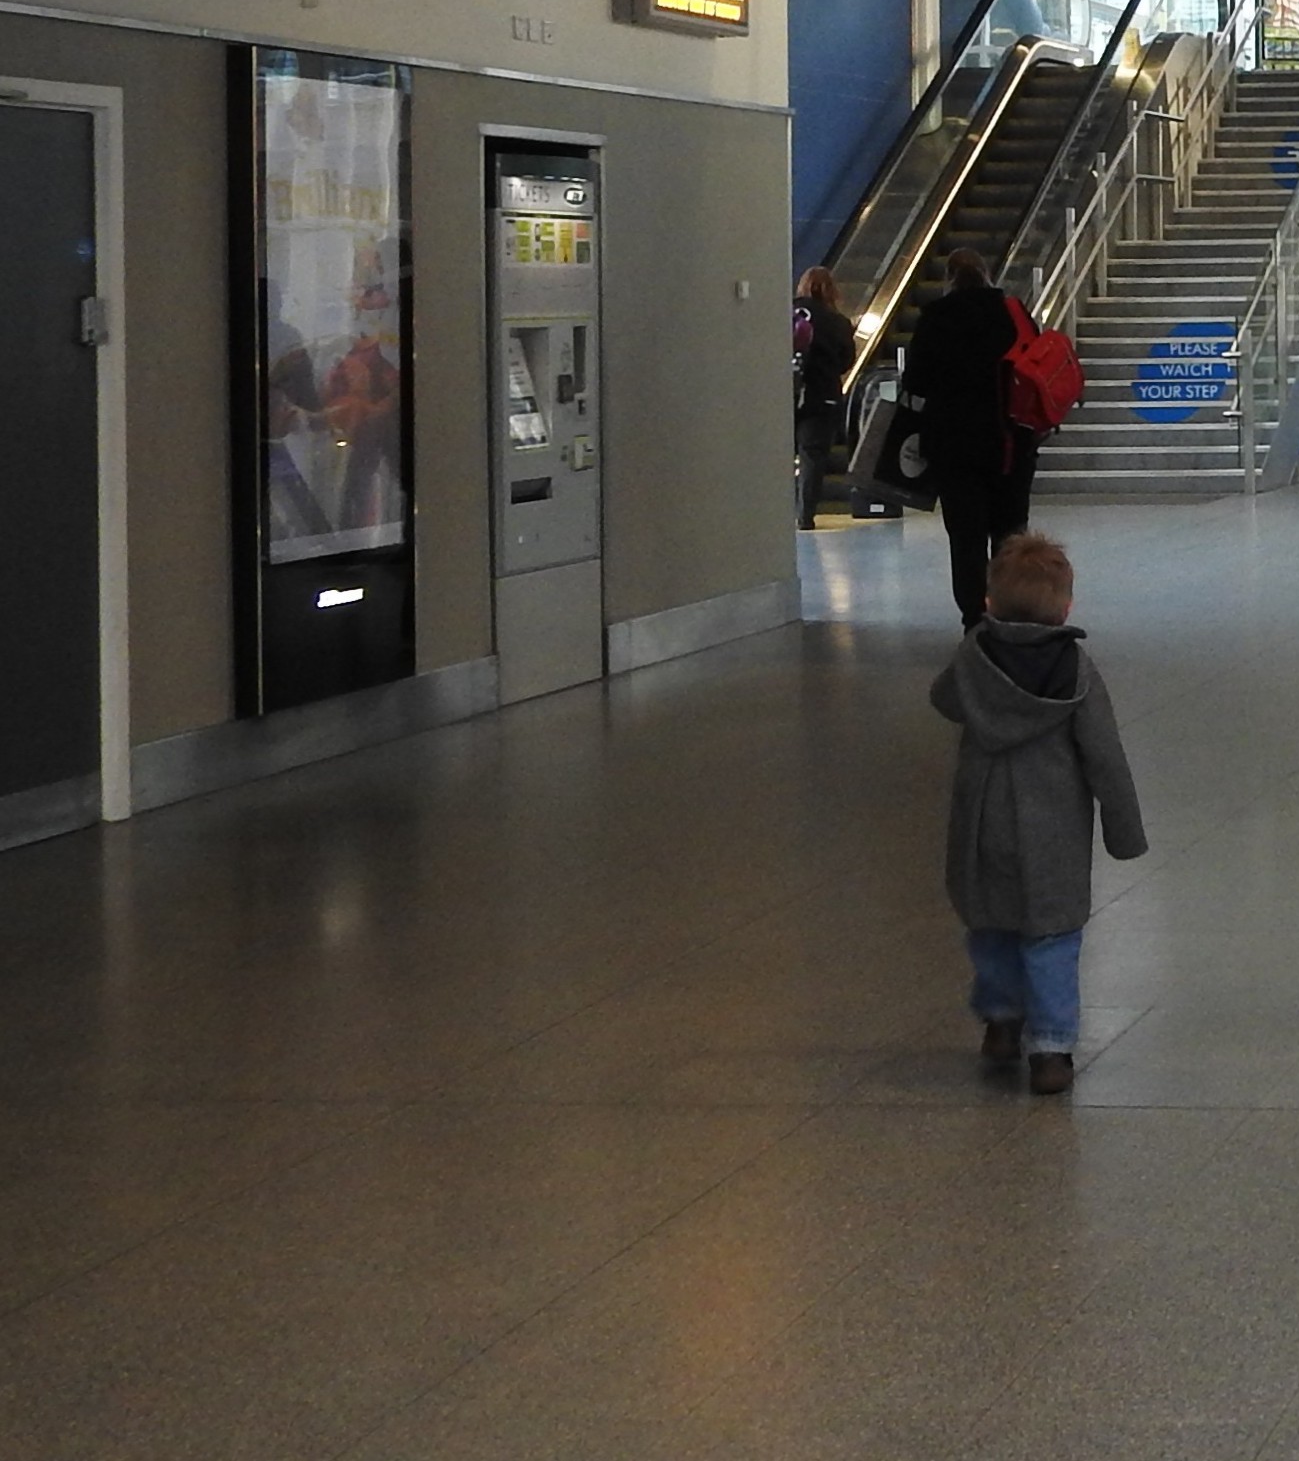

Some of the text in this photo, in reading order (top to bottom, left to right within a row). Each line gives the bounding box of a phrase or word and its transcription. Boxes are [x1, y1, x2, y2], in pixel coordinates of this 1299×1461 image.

[1169, 342, 1218, 356] PLEASE
[1159, 363, 1213, 377] WATCH
[1138, 384, 1219, 399] YOUR STEP
